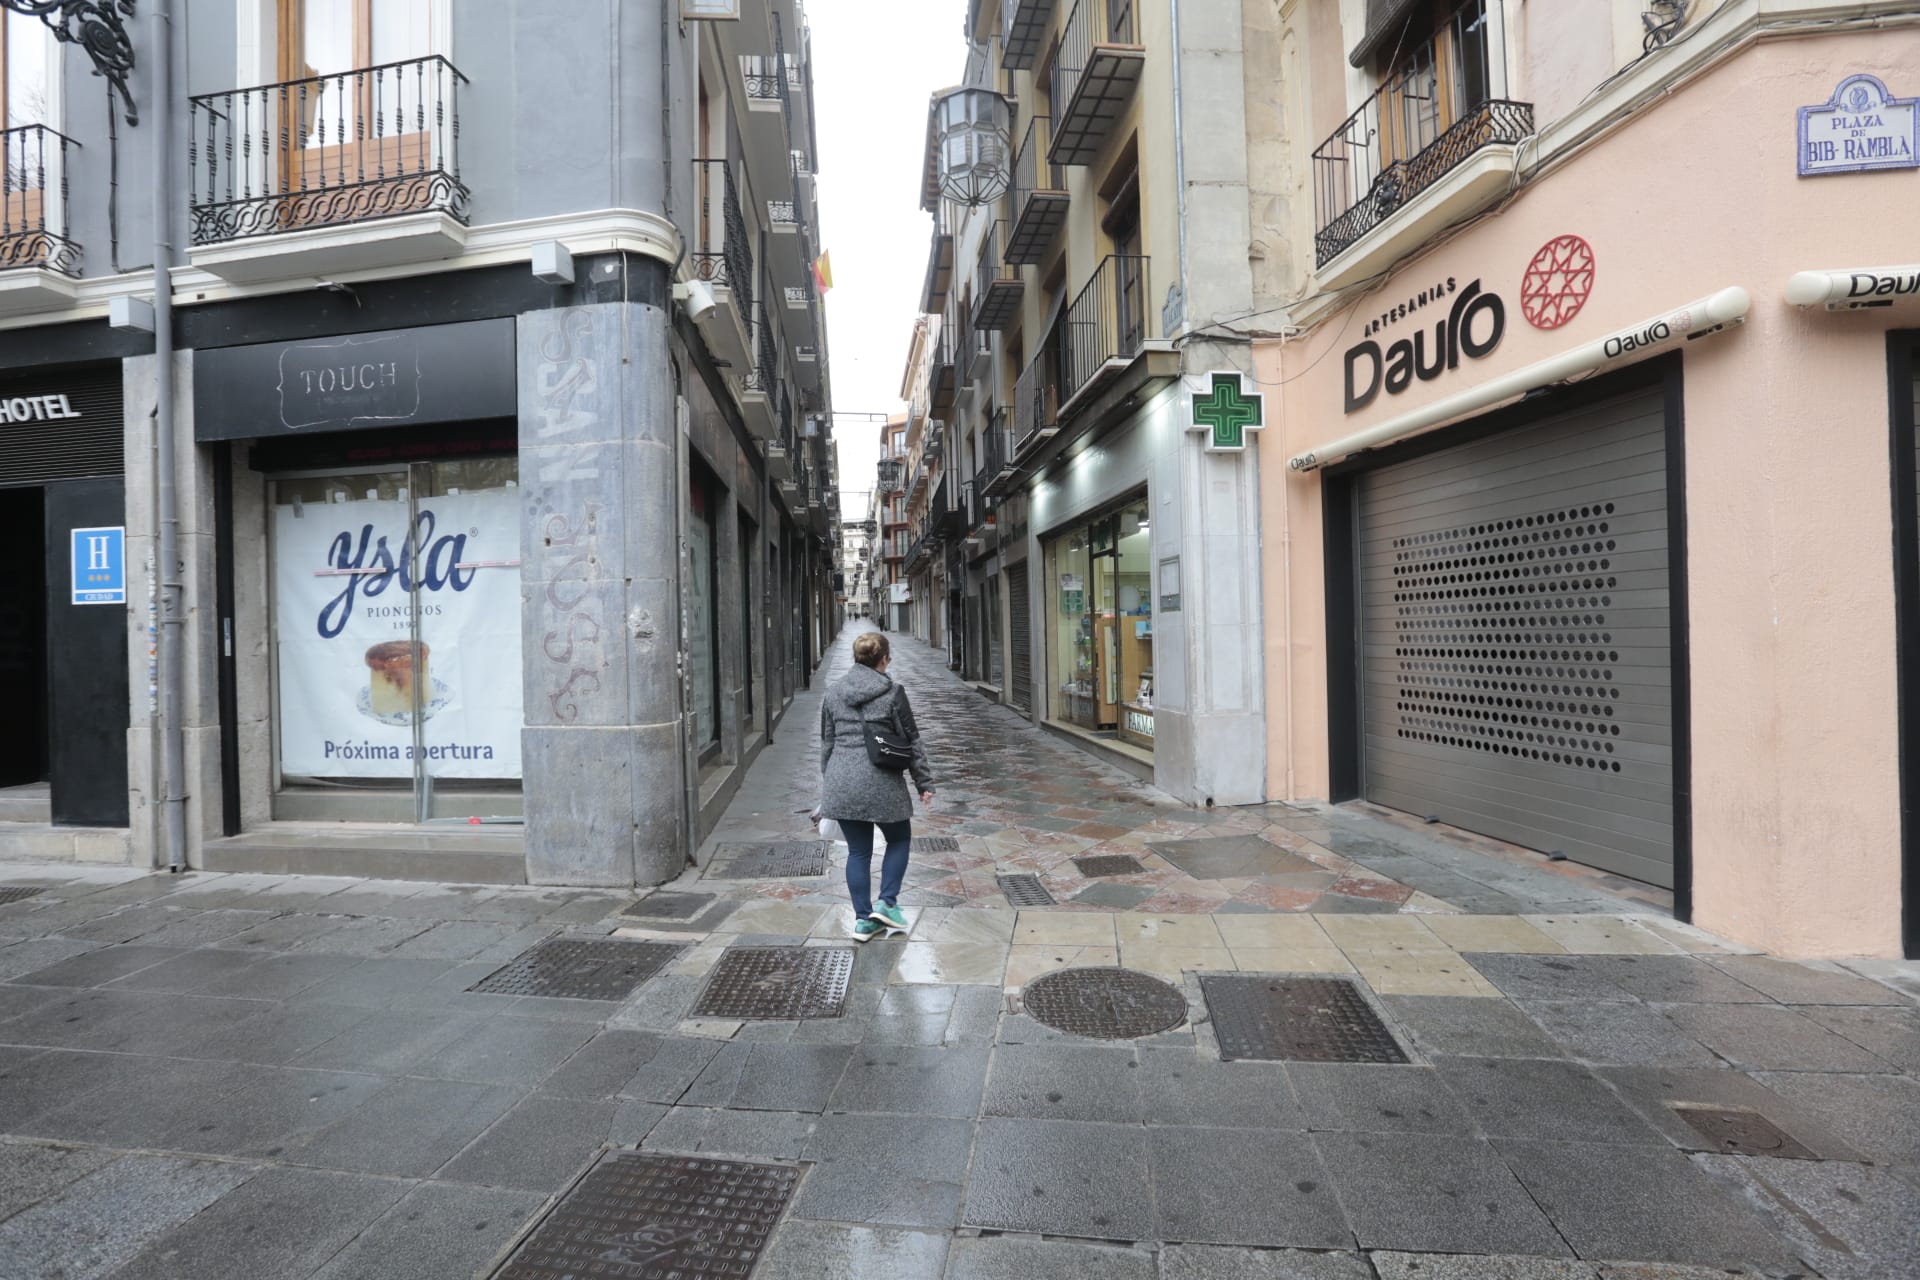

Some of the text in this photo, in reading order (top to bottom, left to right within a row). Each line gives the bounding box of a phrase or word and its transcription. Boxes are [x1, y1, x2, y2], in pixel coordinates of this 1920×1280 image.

[1831, 114, 1884, 130] PLAZA
[1851, 129, 1866, 138] DE
[1808, 135, 1911, 162] BIB- RAMBLA
[1364, 276, 1457, 338] ARTESANIAS
[1344, 278, 1505, 415] Dauro
[1604, 319, 1670, 359] Dauro
[300, 362, 396, 394] TOUCH
[0, 394, 83, 424] HOTEL
[87, 535, 111, 570] H
[323, 739, 400, 760] Próxima
